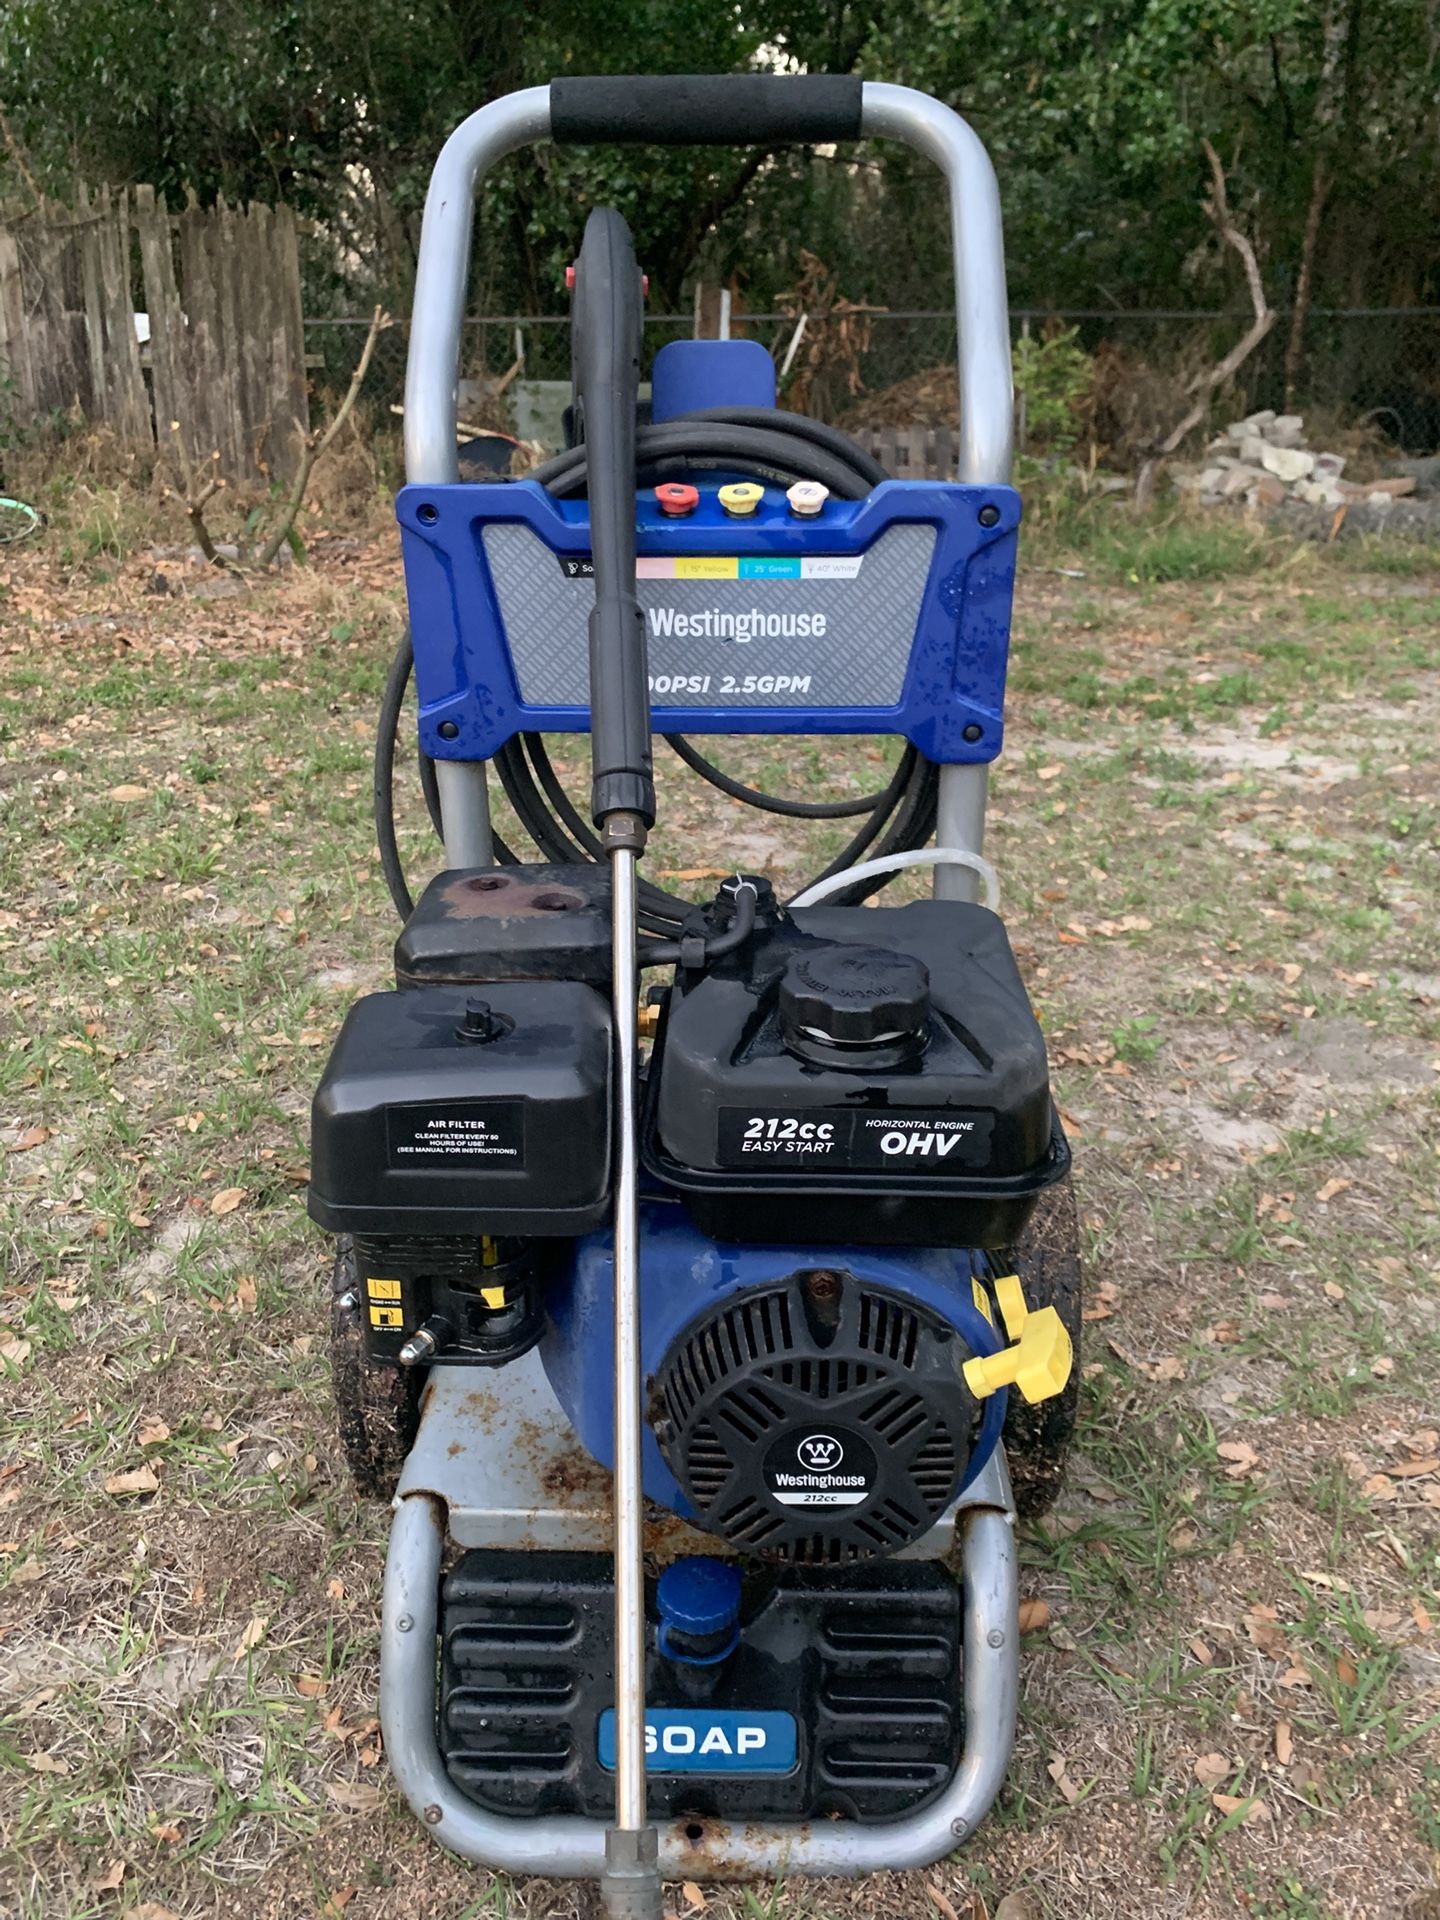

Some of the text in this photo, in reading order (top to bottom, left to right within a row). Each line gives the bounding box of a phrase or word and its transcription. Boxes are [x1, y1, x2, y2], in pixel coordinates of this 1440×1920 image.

[768, 565, 793, 573] Green
[833, 565, 857, 573] White
[649, 608, 827, 643] Westinghouse
[719, 675, 811, 694] 2.5GPM
[427, 1120, 485, 1129] AIR FILTER
[744, 1118, 835, 1140] 212cc
[866, 1119, 975, 1131] HORIZONTAL ENGINE
[742, 1140, 835, 1153] EASY START
[880, 1131, 962, 1157] OHV
[462, 1147, 517, 1156] INSTRUCTIONS)
[775, 1473, 866, 1489] Westinghouse
